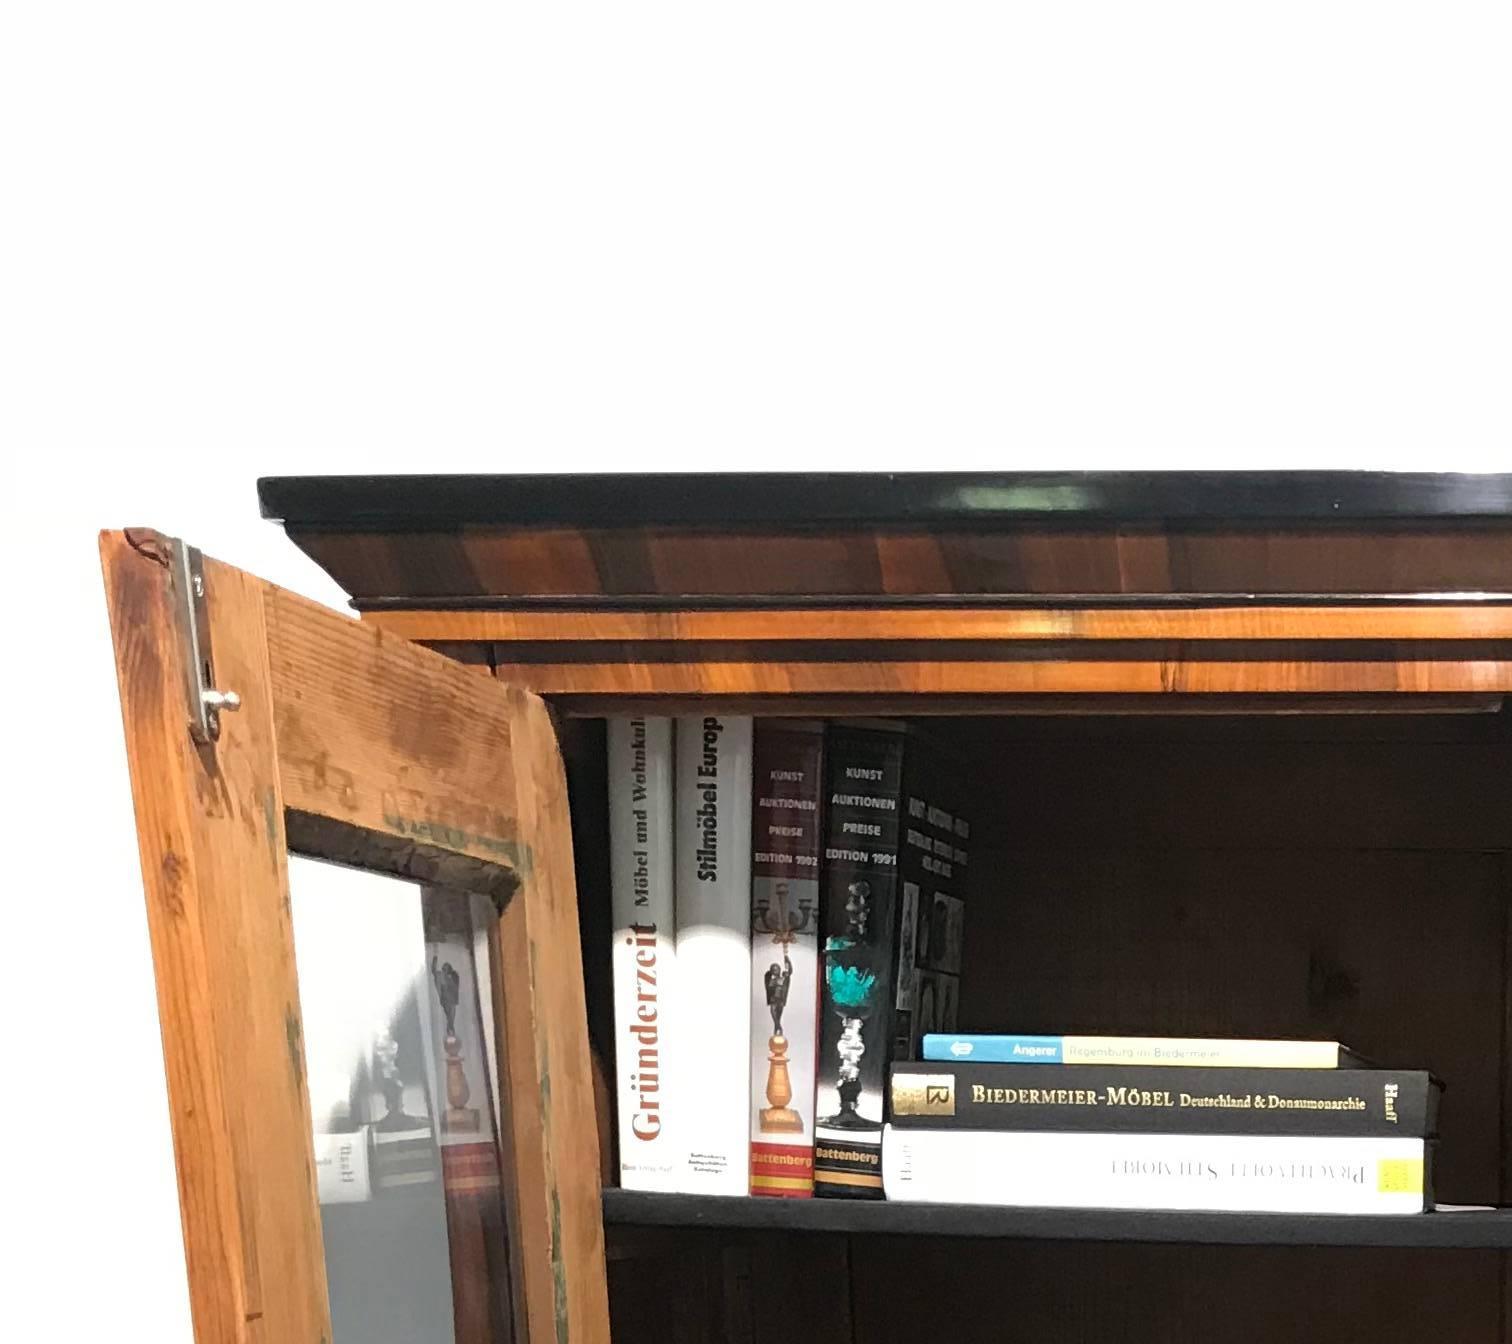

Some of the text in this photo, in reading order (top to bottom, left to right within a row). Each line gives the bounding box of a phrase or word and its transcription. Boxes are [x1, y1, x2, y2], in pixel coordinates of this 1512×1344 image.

[770, 769, 804, 782] KUNST
[846, 767, 883, 781] KUNST
[759, 798, 816, 811] AUKTIONEN
[832, 793, 896, 811] AUKTIONEN
[696, 782, 718, 882] Stilmöbel
[768, 825, 803, 837] PREISE
[842, 823, 881, 836] PREISE
[755, 852, 793, 864] EDITION
[825, 848, 897, 865] EDITION 1991
[626, 810, 661, 1142] Gründerzeit Möbel und
[1012, 1042, 1058, 1057] Angerer
[971, 1083, 1366, 1111] BIEDERMEIER-MÖBEL Deutschland & Donaumonarchie
[1384, 1083, 1399, 1124] Haaff
[752, 1151, 812, 1168] Battenberg
[815, 1146, 879, 1164] Battenberg
